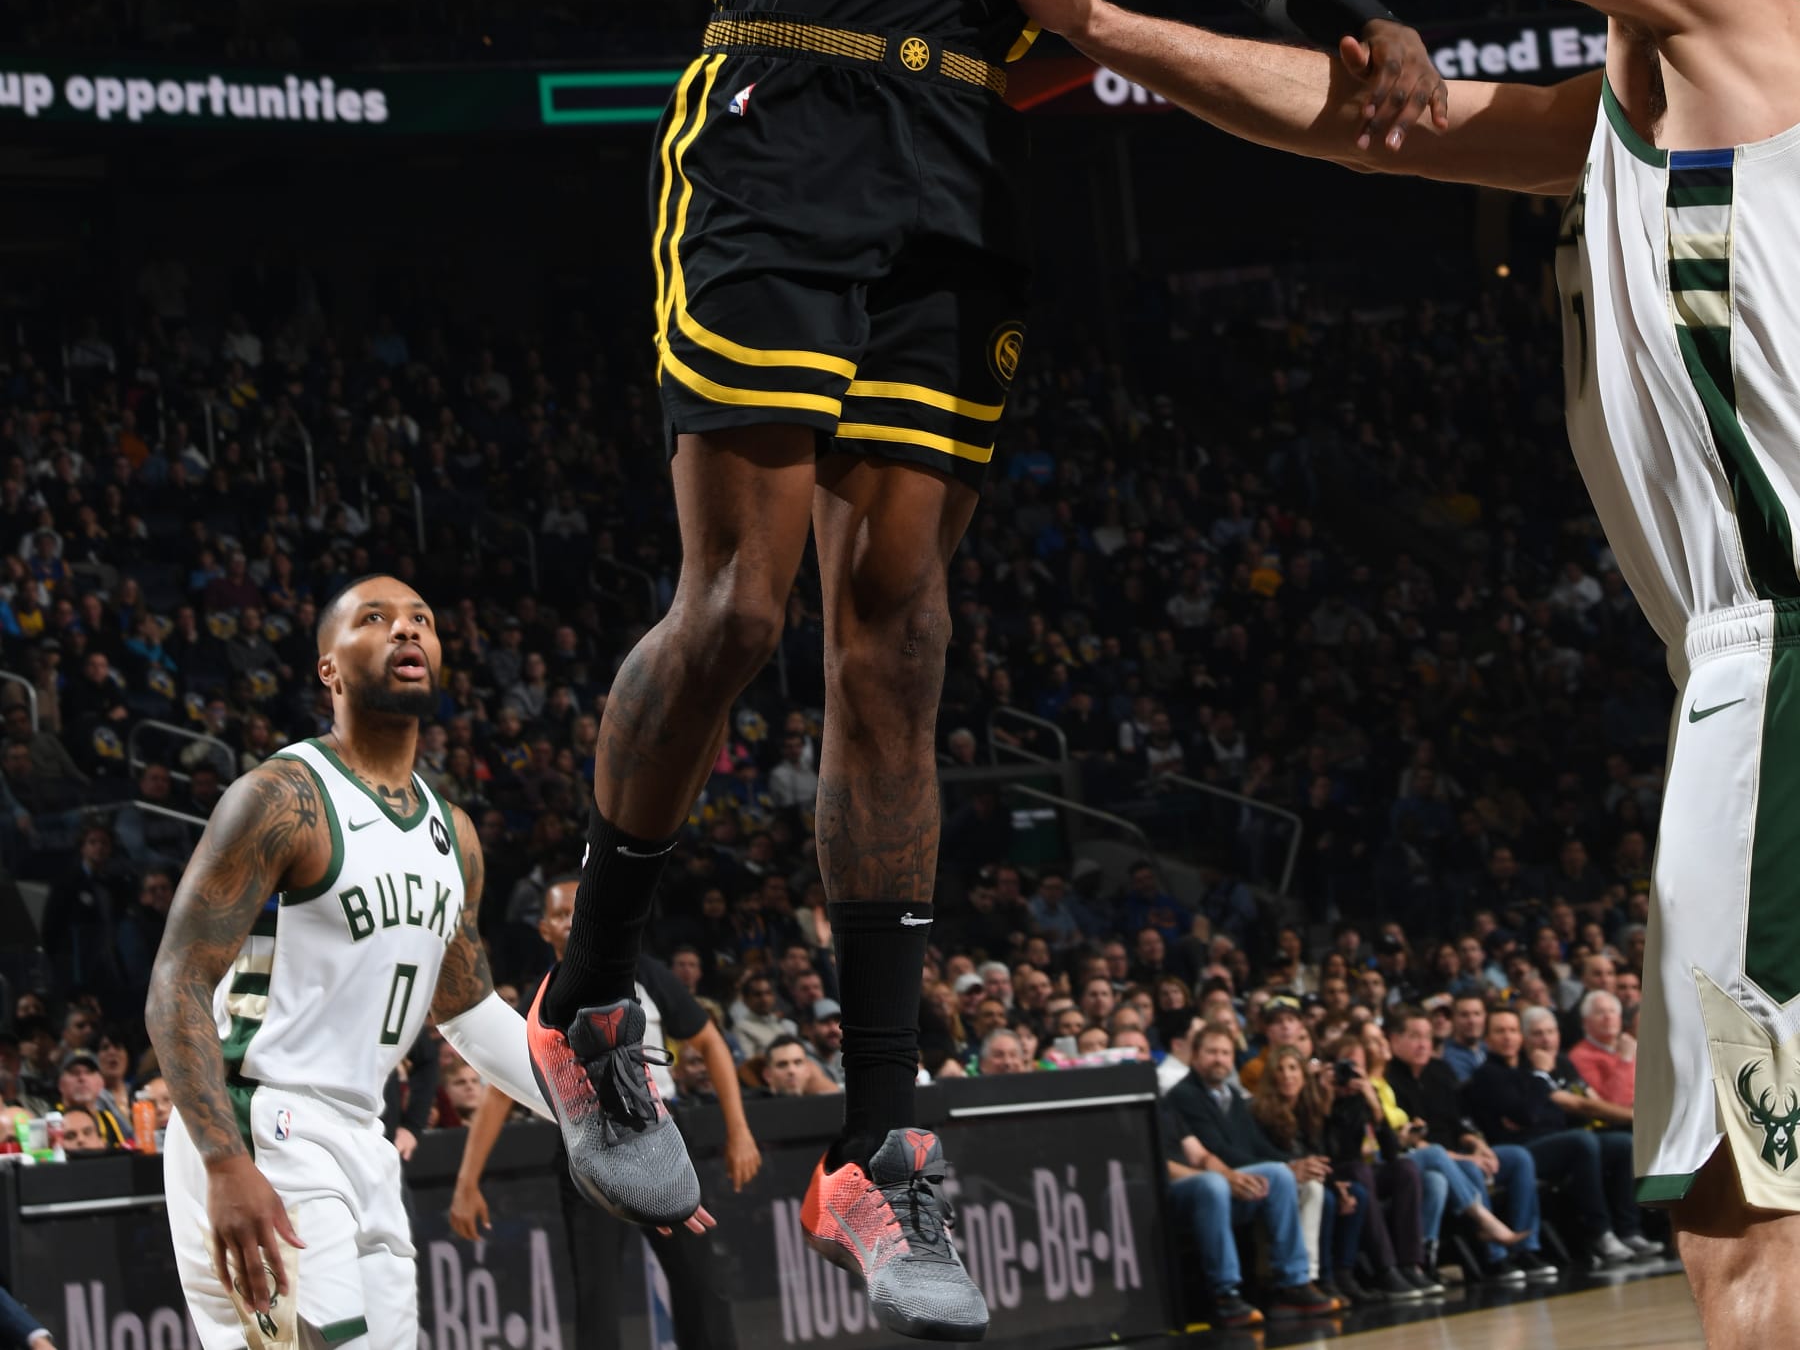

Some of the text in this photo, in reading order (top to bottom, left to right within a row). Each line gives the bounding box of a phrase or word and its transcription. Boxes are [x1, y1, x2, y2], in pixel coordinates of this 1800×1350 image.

[1434, 28, 1541, 79] cted
[64, 74, 389, 123] opportunities
[379, 961, 419, 1046] 0
